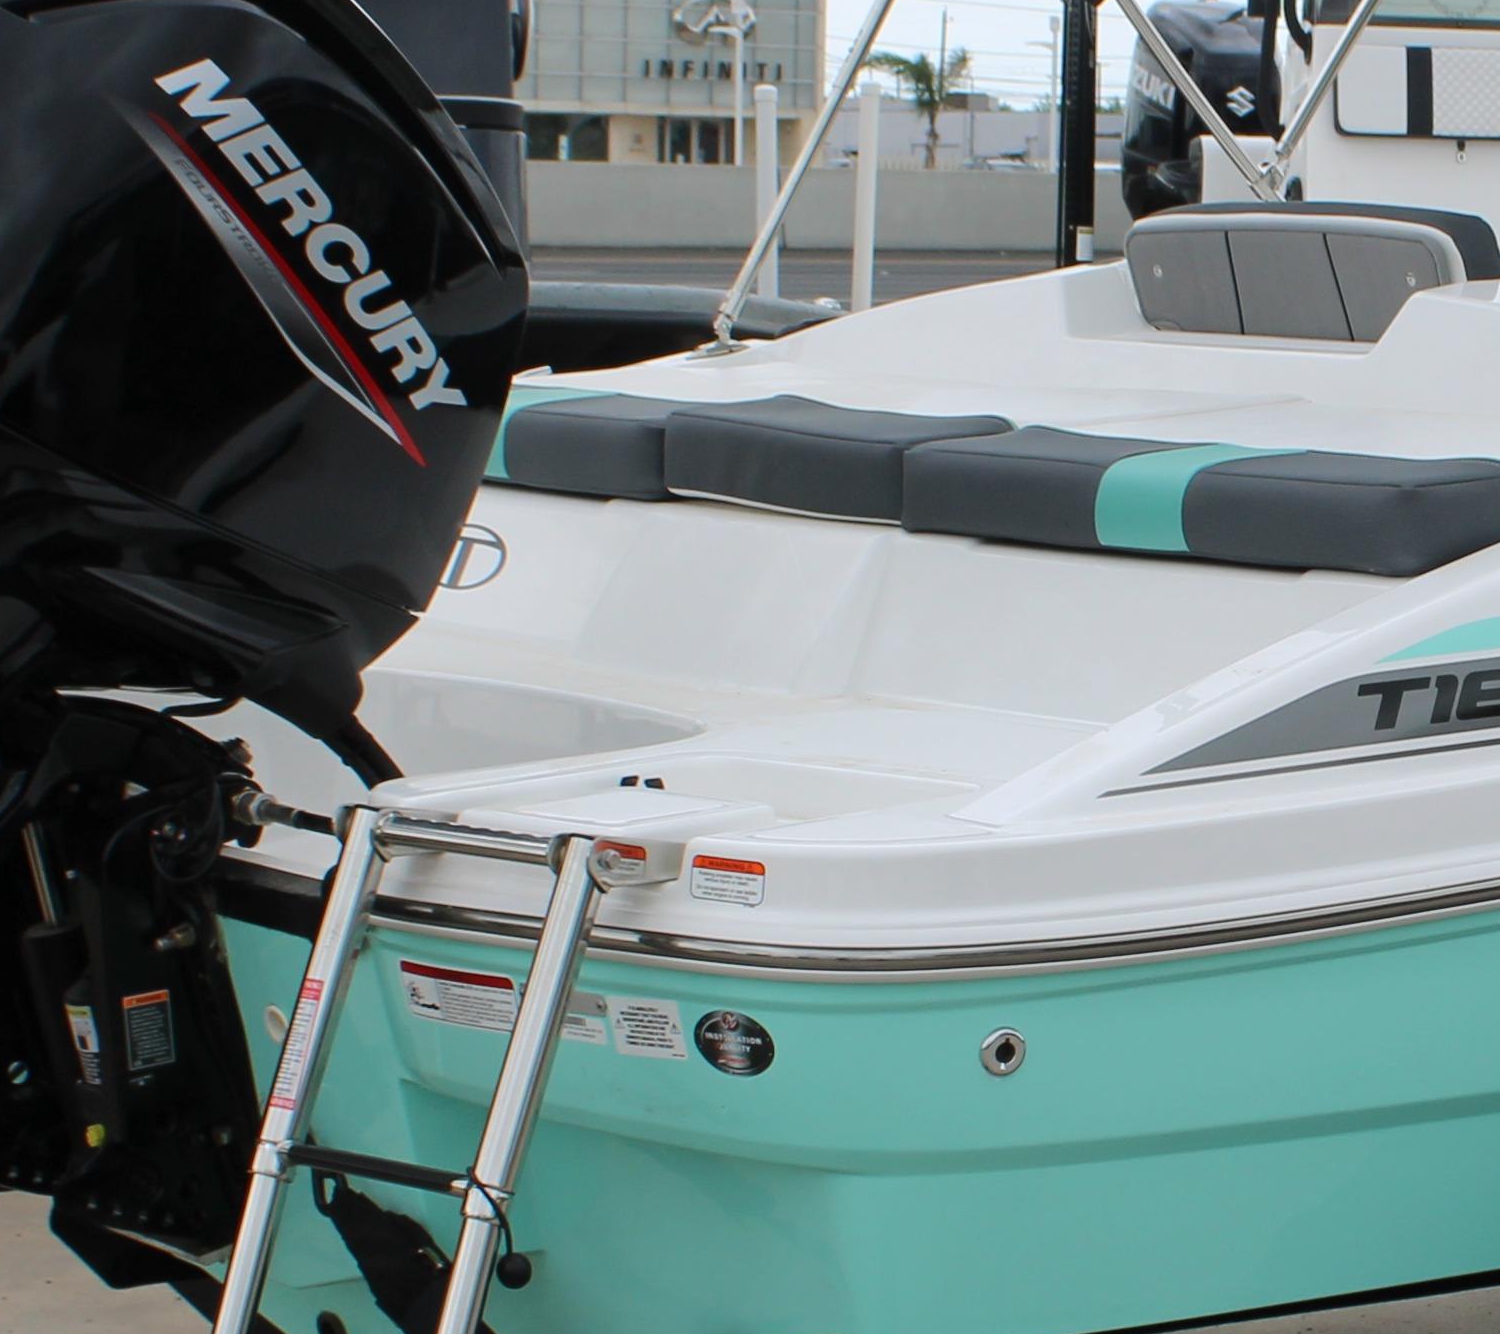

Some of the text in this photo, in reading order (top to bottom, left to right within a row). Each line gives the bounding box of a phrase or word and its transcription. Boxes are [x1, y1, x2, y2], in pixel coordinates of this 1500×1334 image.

[643, 58, 784, 82] INFINITI
[154, 58, 468, 410] MERCURY
[704, 1031, 763, 1046] INSTATION
